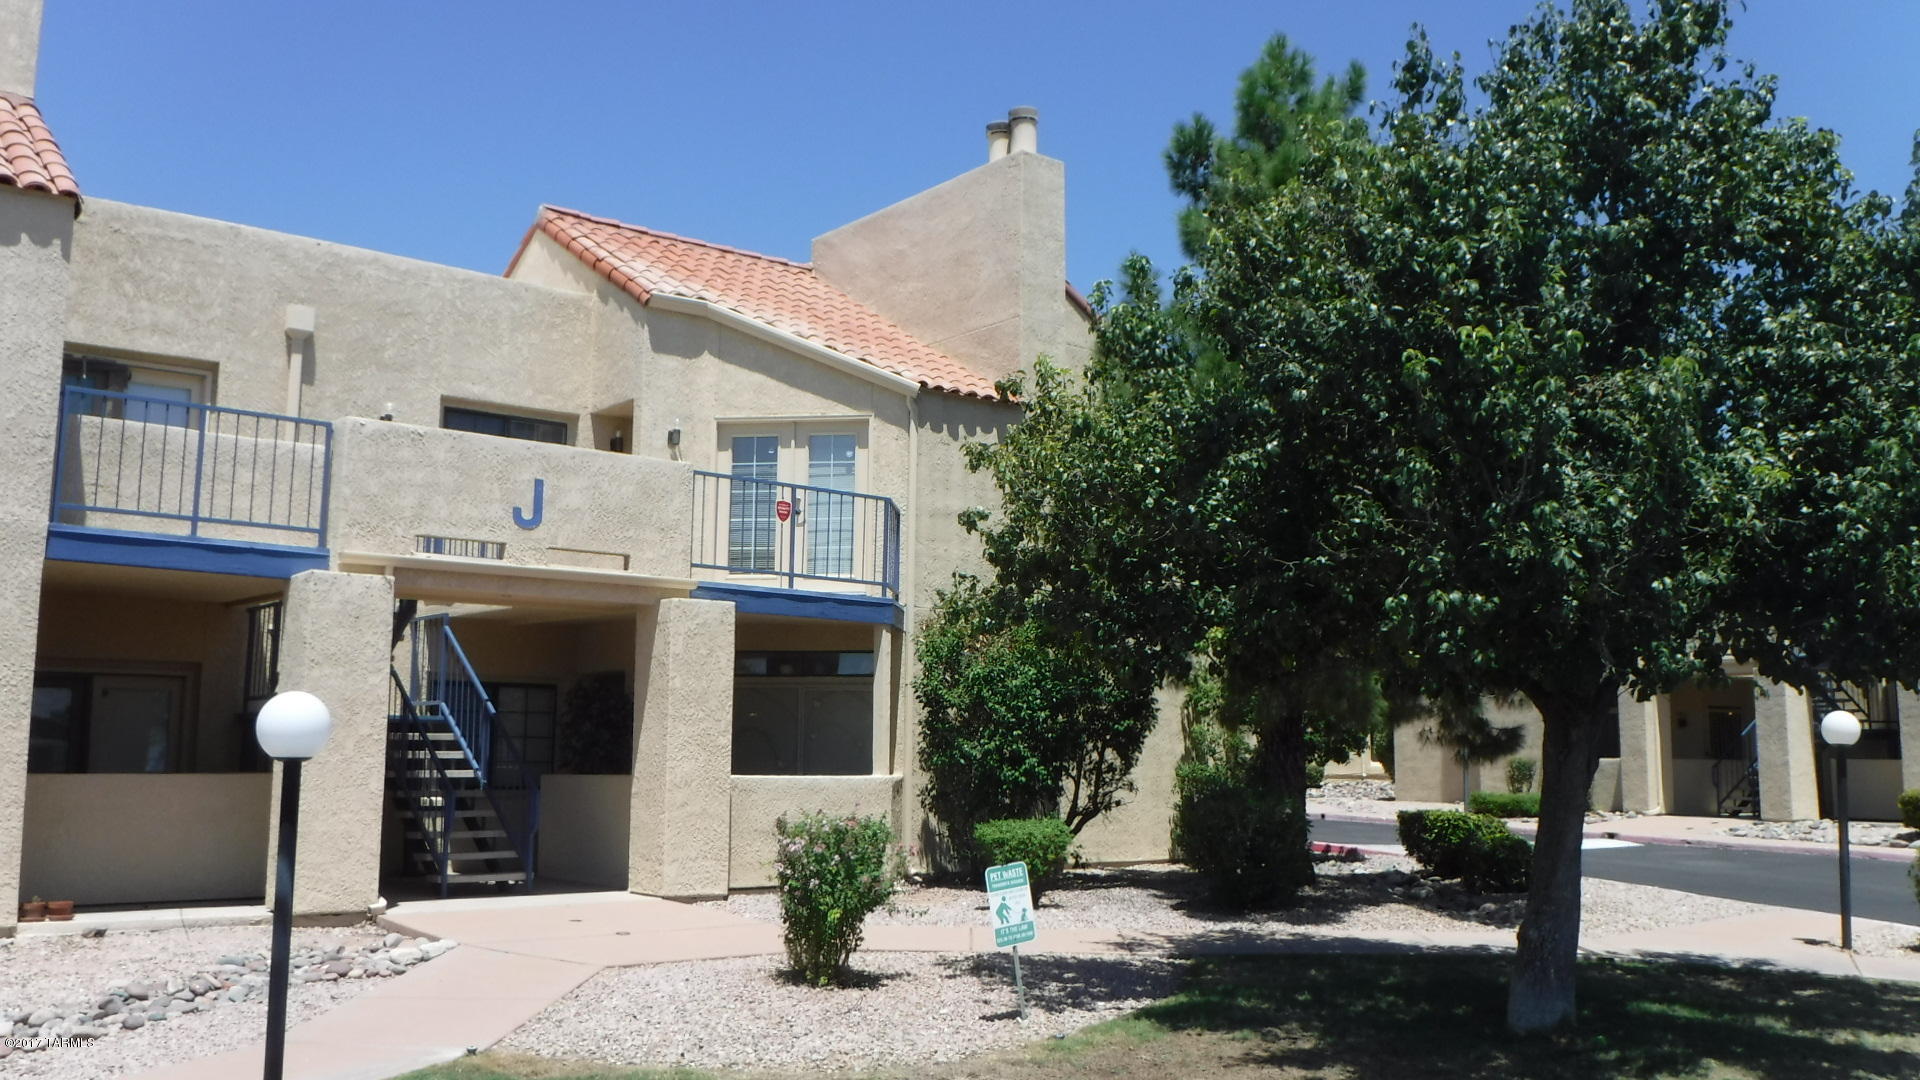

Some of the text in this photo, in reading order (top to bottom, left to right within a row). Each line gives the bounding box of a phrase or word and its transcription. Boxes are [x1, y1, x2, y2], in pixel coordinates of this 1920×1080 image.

[512, 478, 544, 530] J
[989, 867, 1024, 881] PET WASTE
